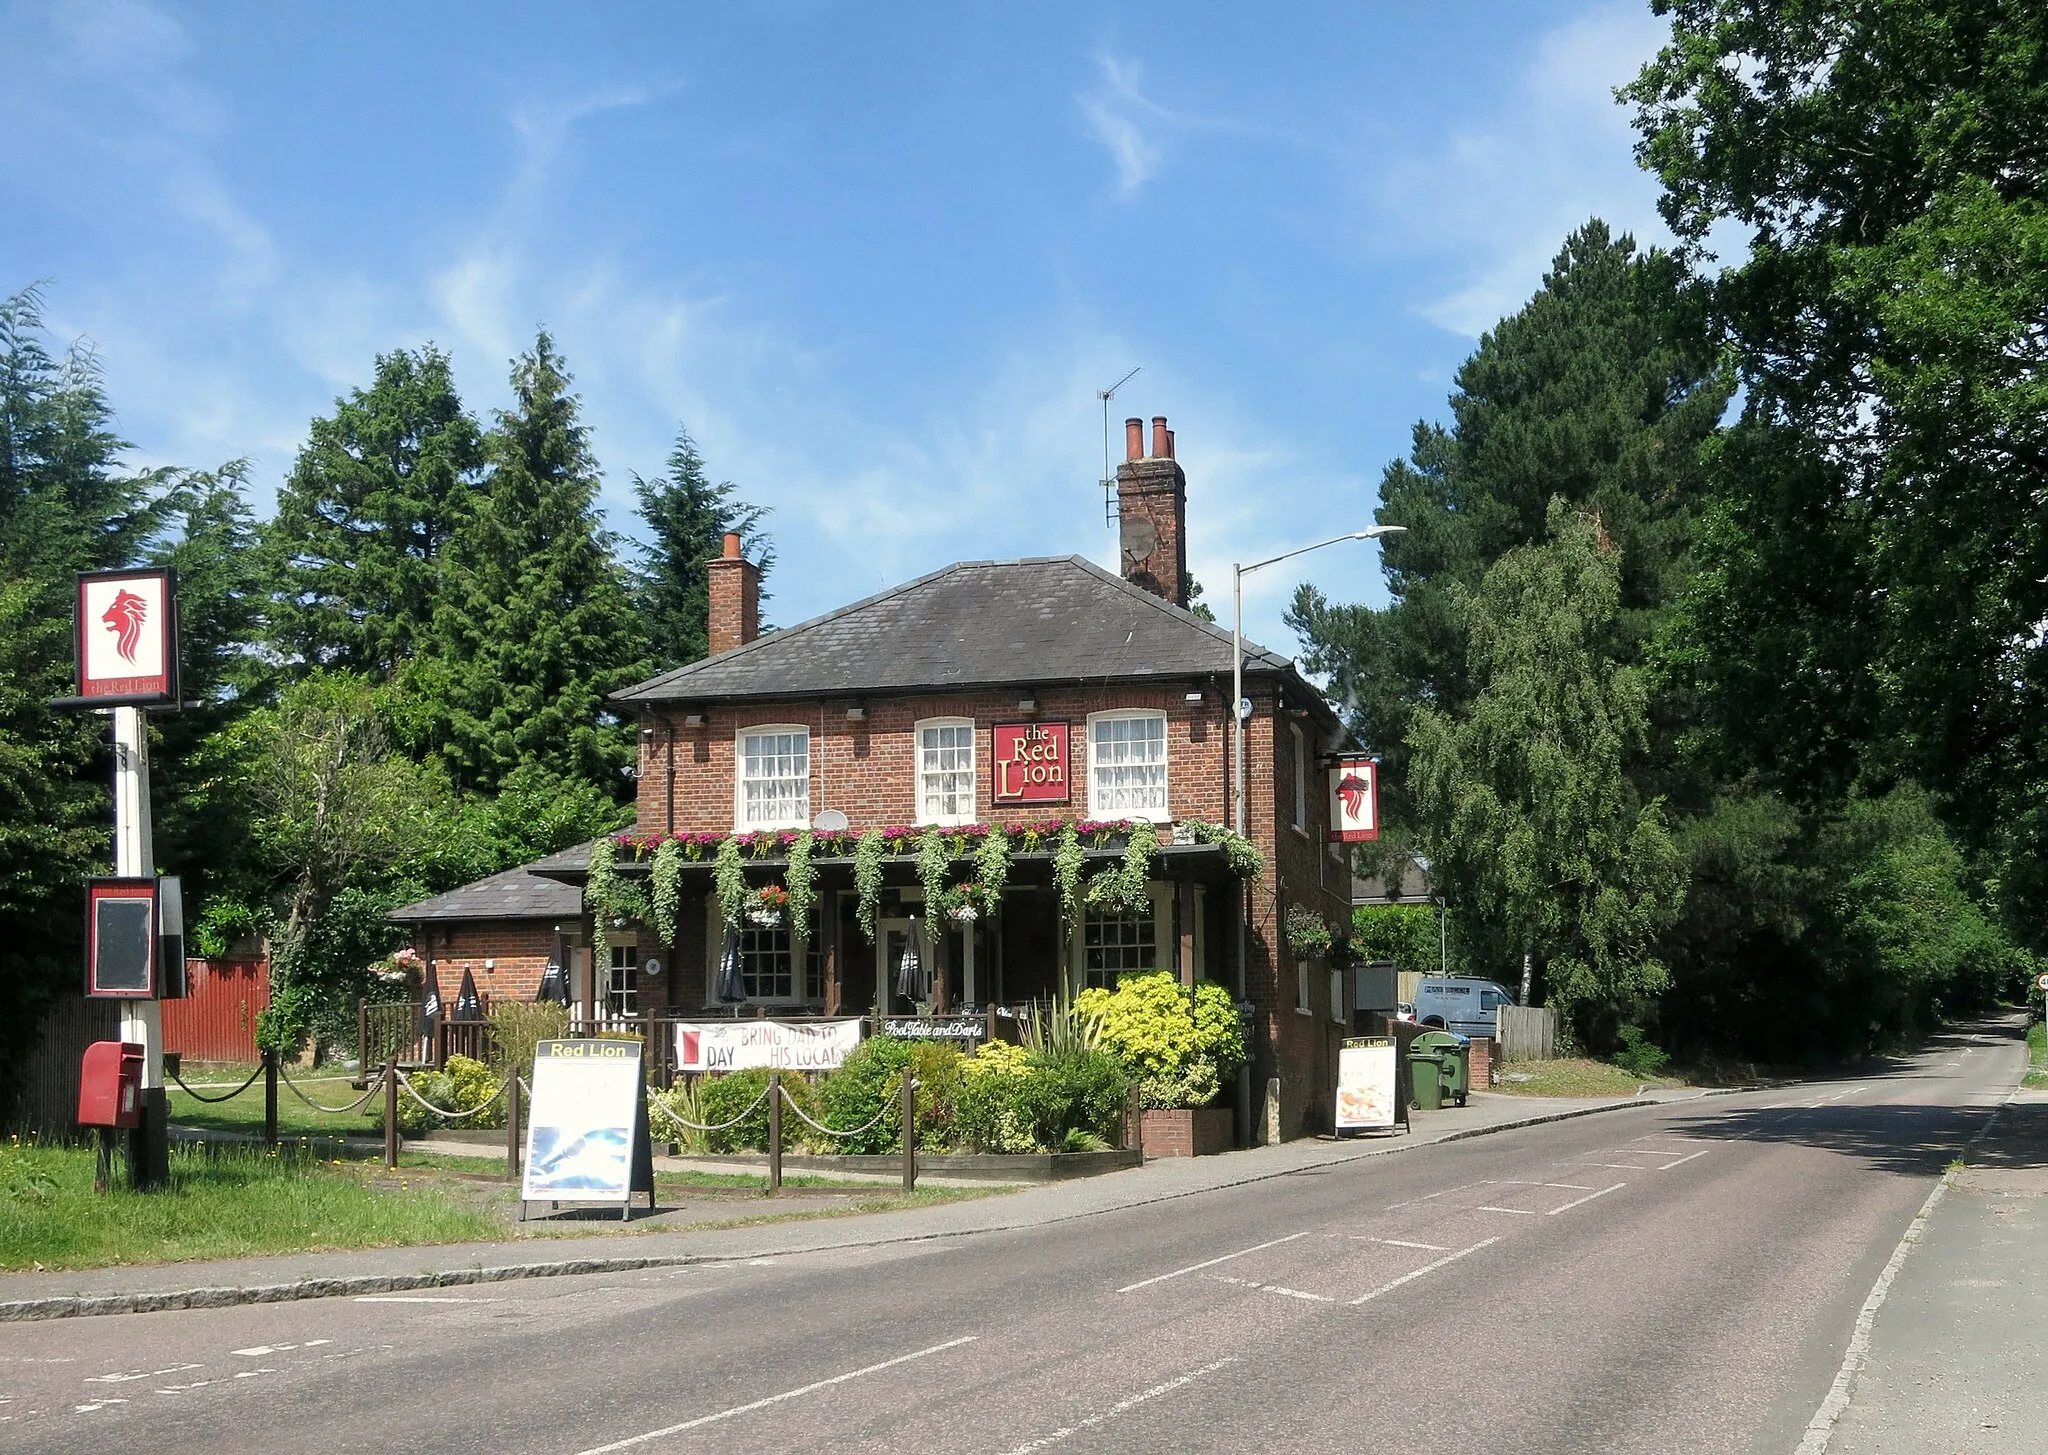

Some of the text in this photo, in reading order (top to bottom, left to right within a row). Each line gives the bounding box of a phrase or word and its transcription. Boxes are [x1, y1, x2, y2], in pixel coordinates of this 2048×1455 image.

[91, 680, 160, 694] the Red Lion
[1026, 724, 1049, 740] the
[1012, 735, 1059, 761] Red
[997, 759, 1063, 797] Lion
[1343, 831, 1356, 840] Red
[1357, 831, 1373, 839] Lion
[741, 1026, 781, 1046] BRING
[884, 1020, 982, 1037] Pool Table and Darts
[551, 1043, 626, 1057] Red Lion
[1346, 1039, 1388, 1048] Red Lion
[707, 1046, 735, 1067] DAY
[770, 1046, 838, 1067] HIS LOCAL
